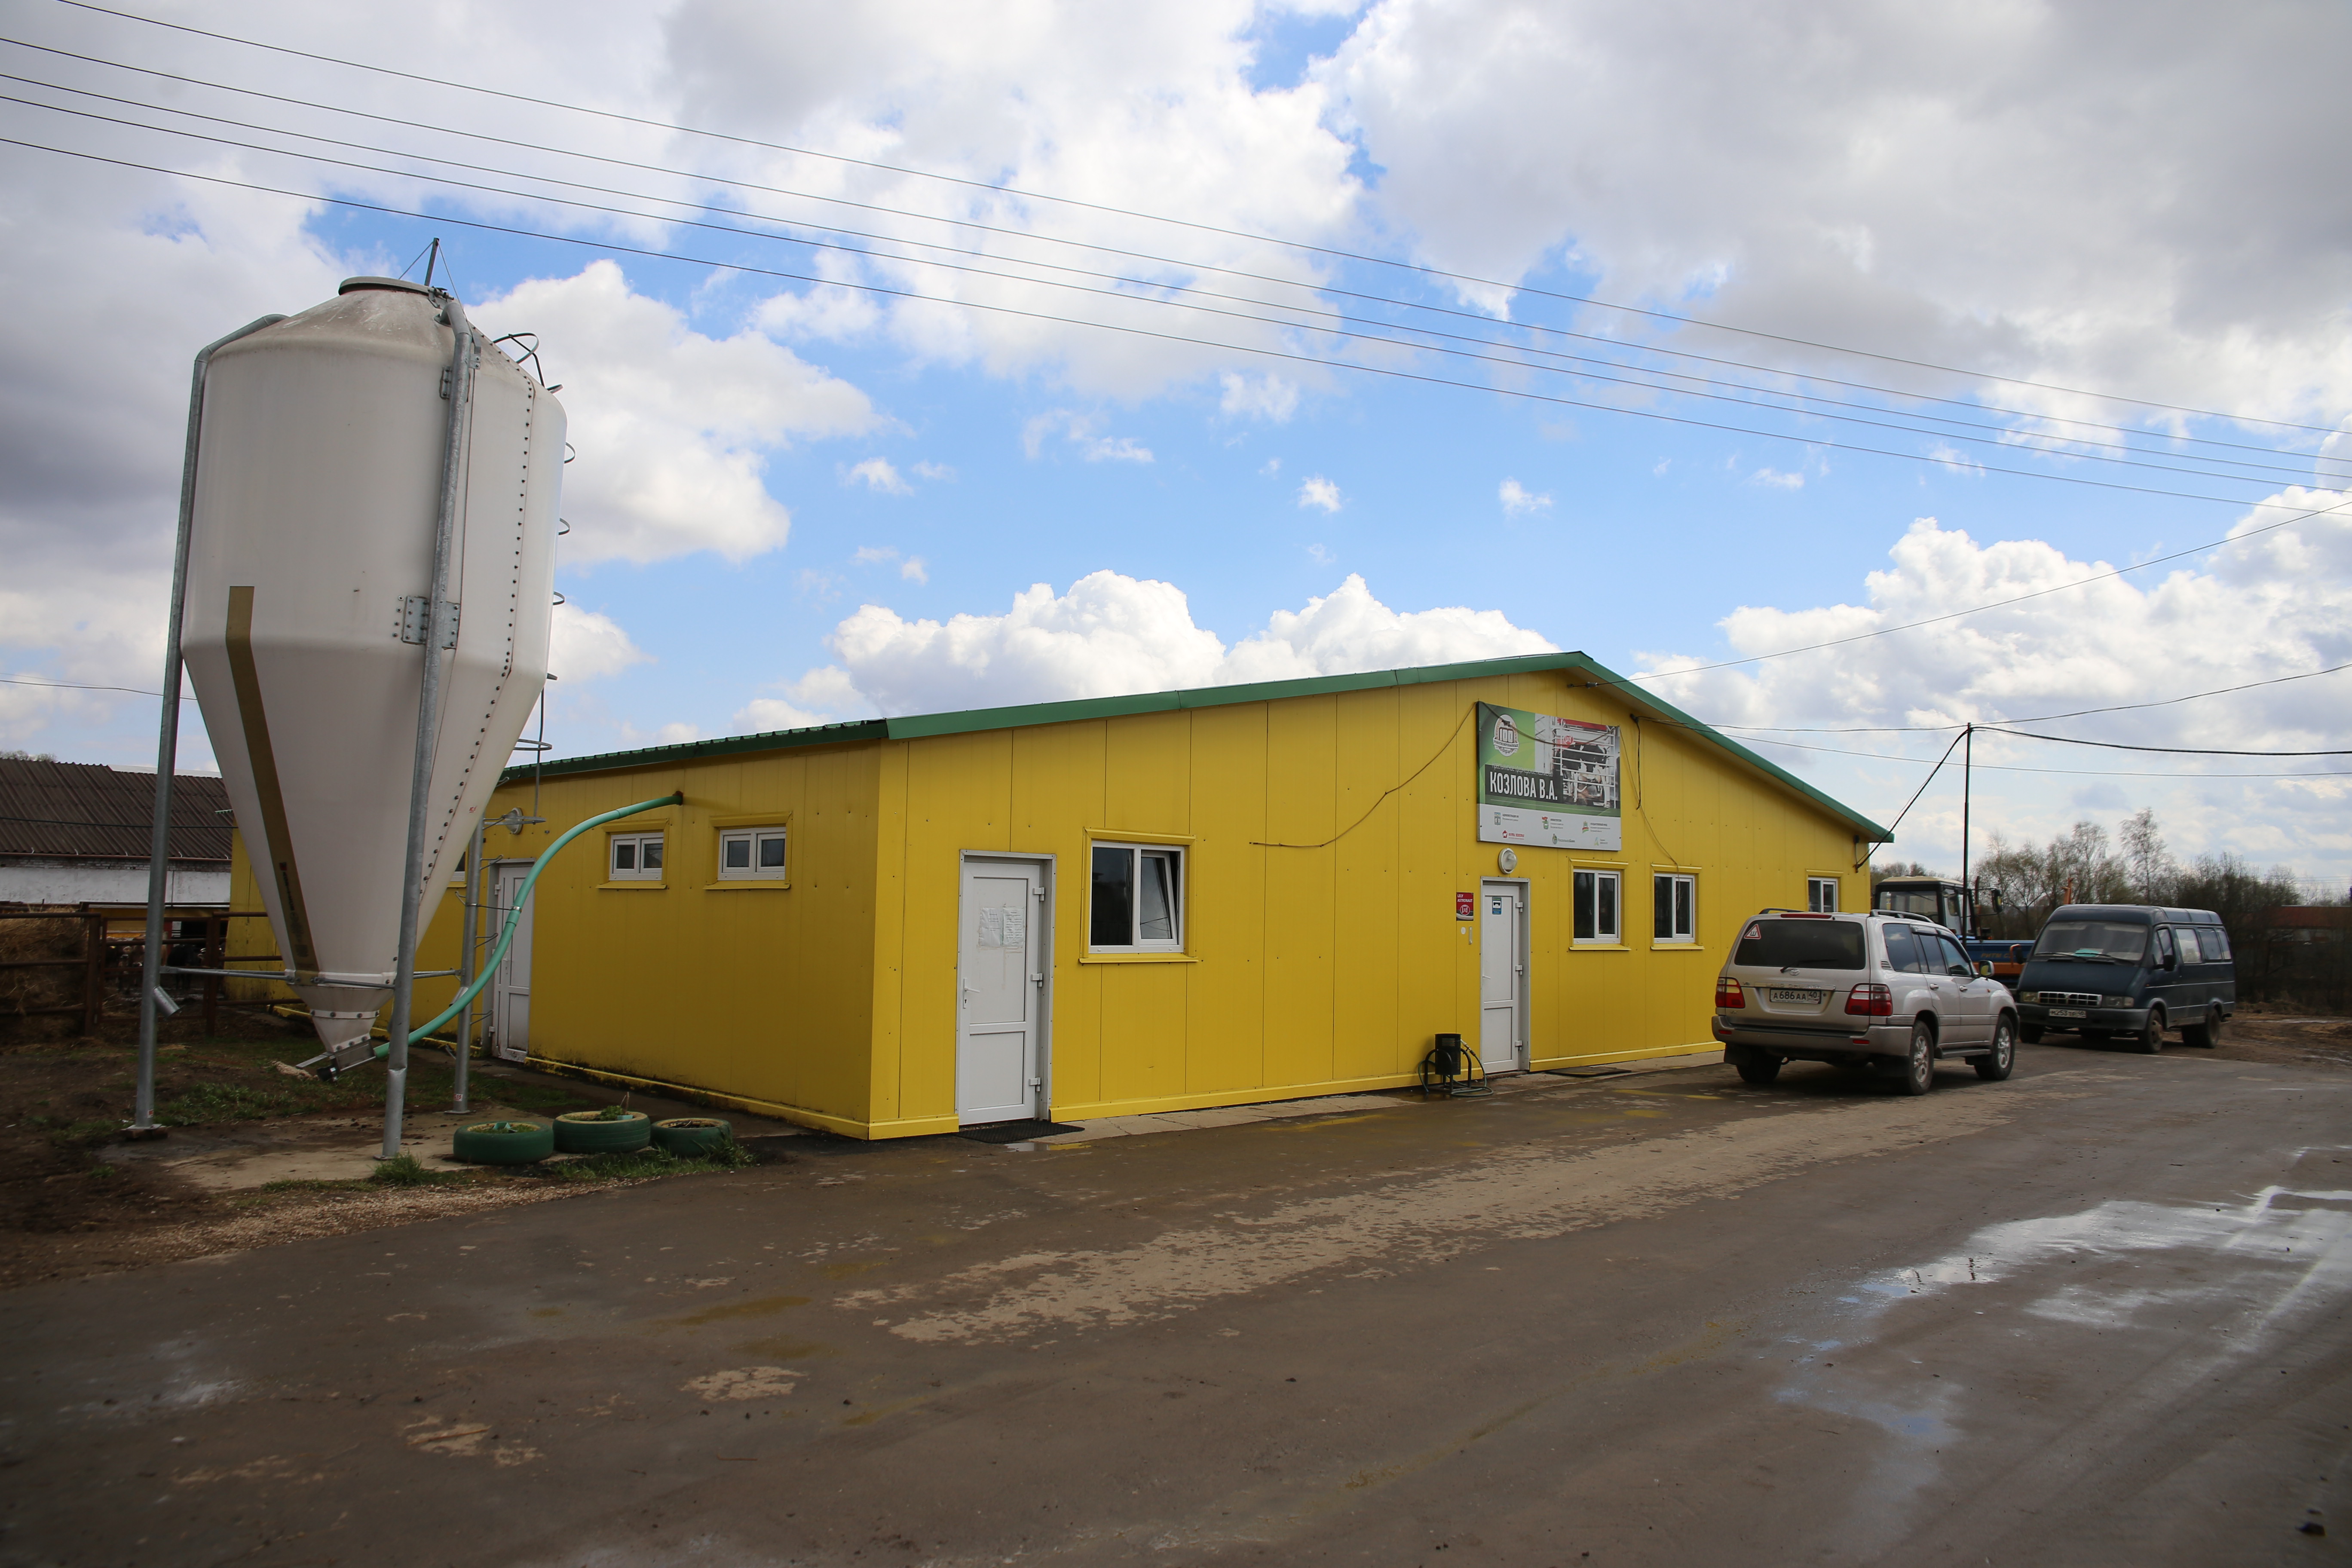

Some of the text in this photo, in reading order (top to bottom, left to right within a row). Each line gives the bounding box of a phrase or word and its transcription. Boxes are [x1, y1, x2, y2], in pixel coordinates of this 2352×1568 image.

[1500, 729, 1513, 743] 100
[1490, 771, 1558, 800] КОЗЛОВА В.А.
